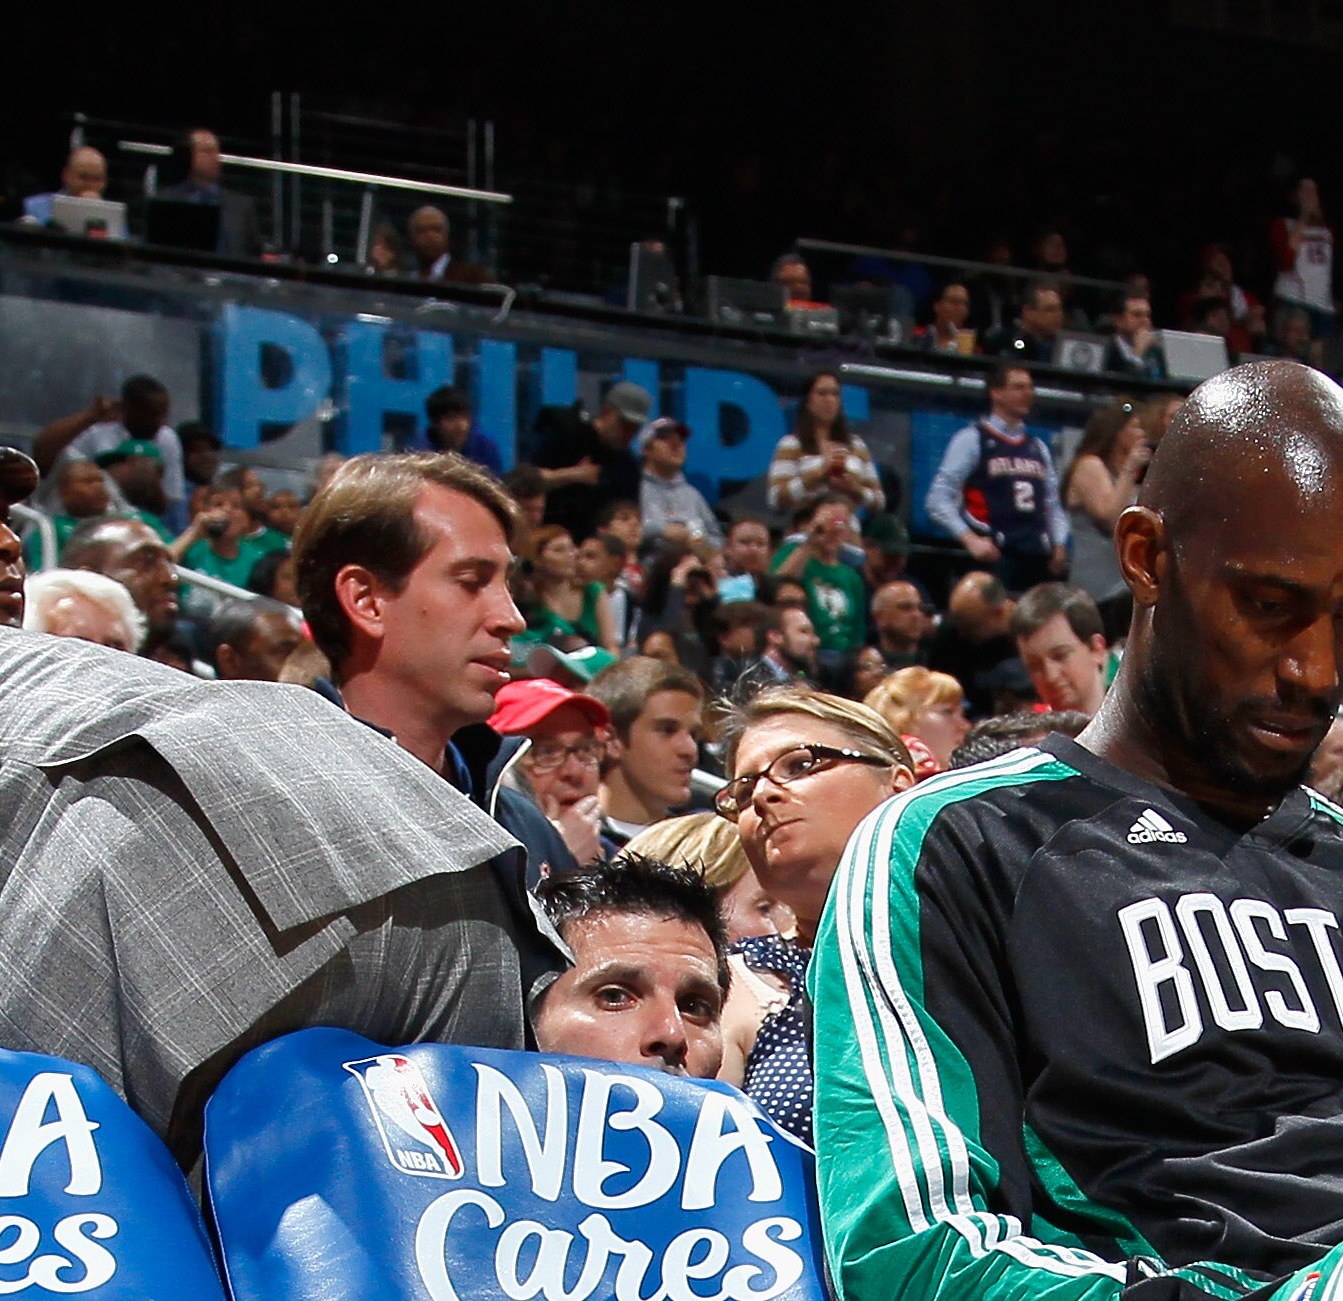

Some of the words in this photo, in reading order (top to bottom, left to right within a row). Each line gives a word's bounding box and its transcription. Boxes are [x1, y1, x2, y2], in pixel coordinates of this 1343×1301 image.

[1014, 480, 1036, 512] 2
[1126, 828, 1188, 844] adidas
[470, 1062, 783, 1211] NBA
[395, 1149, 442, 1172] NBA
